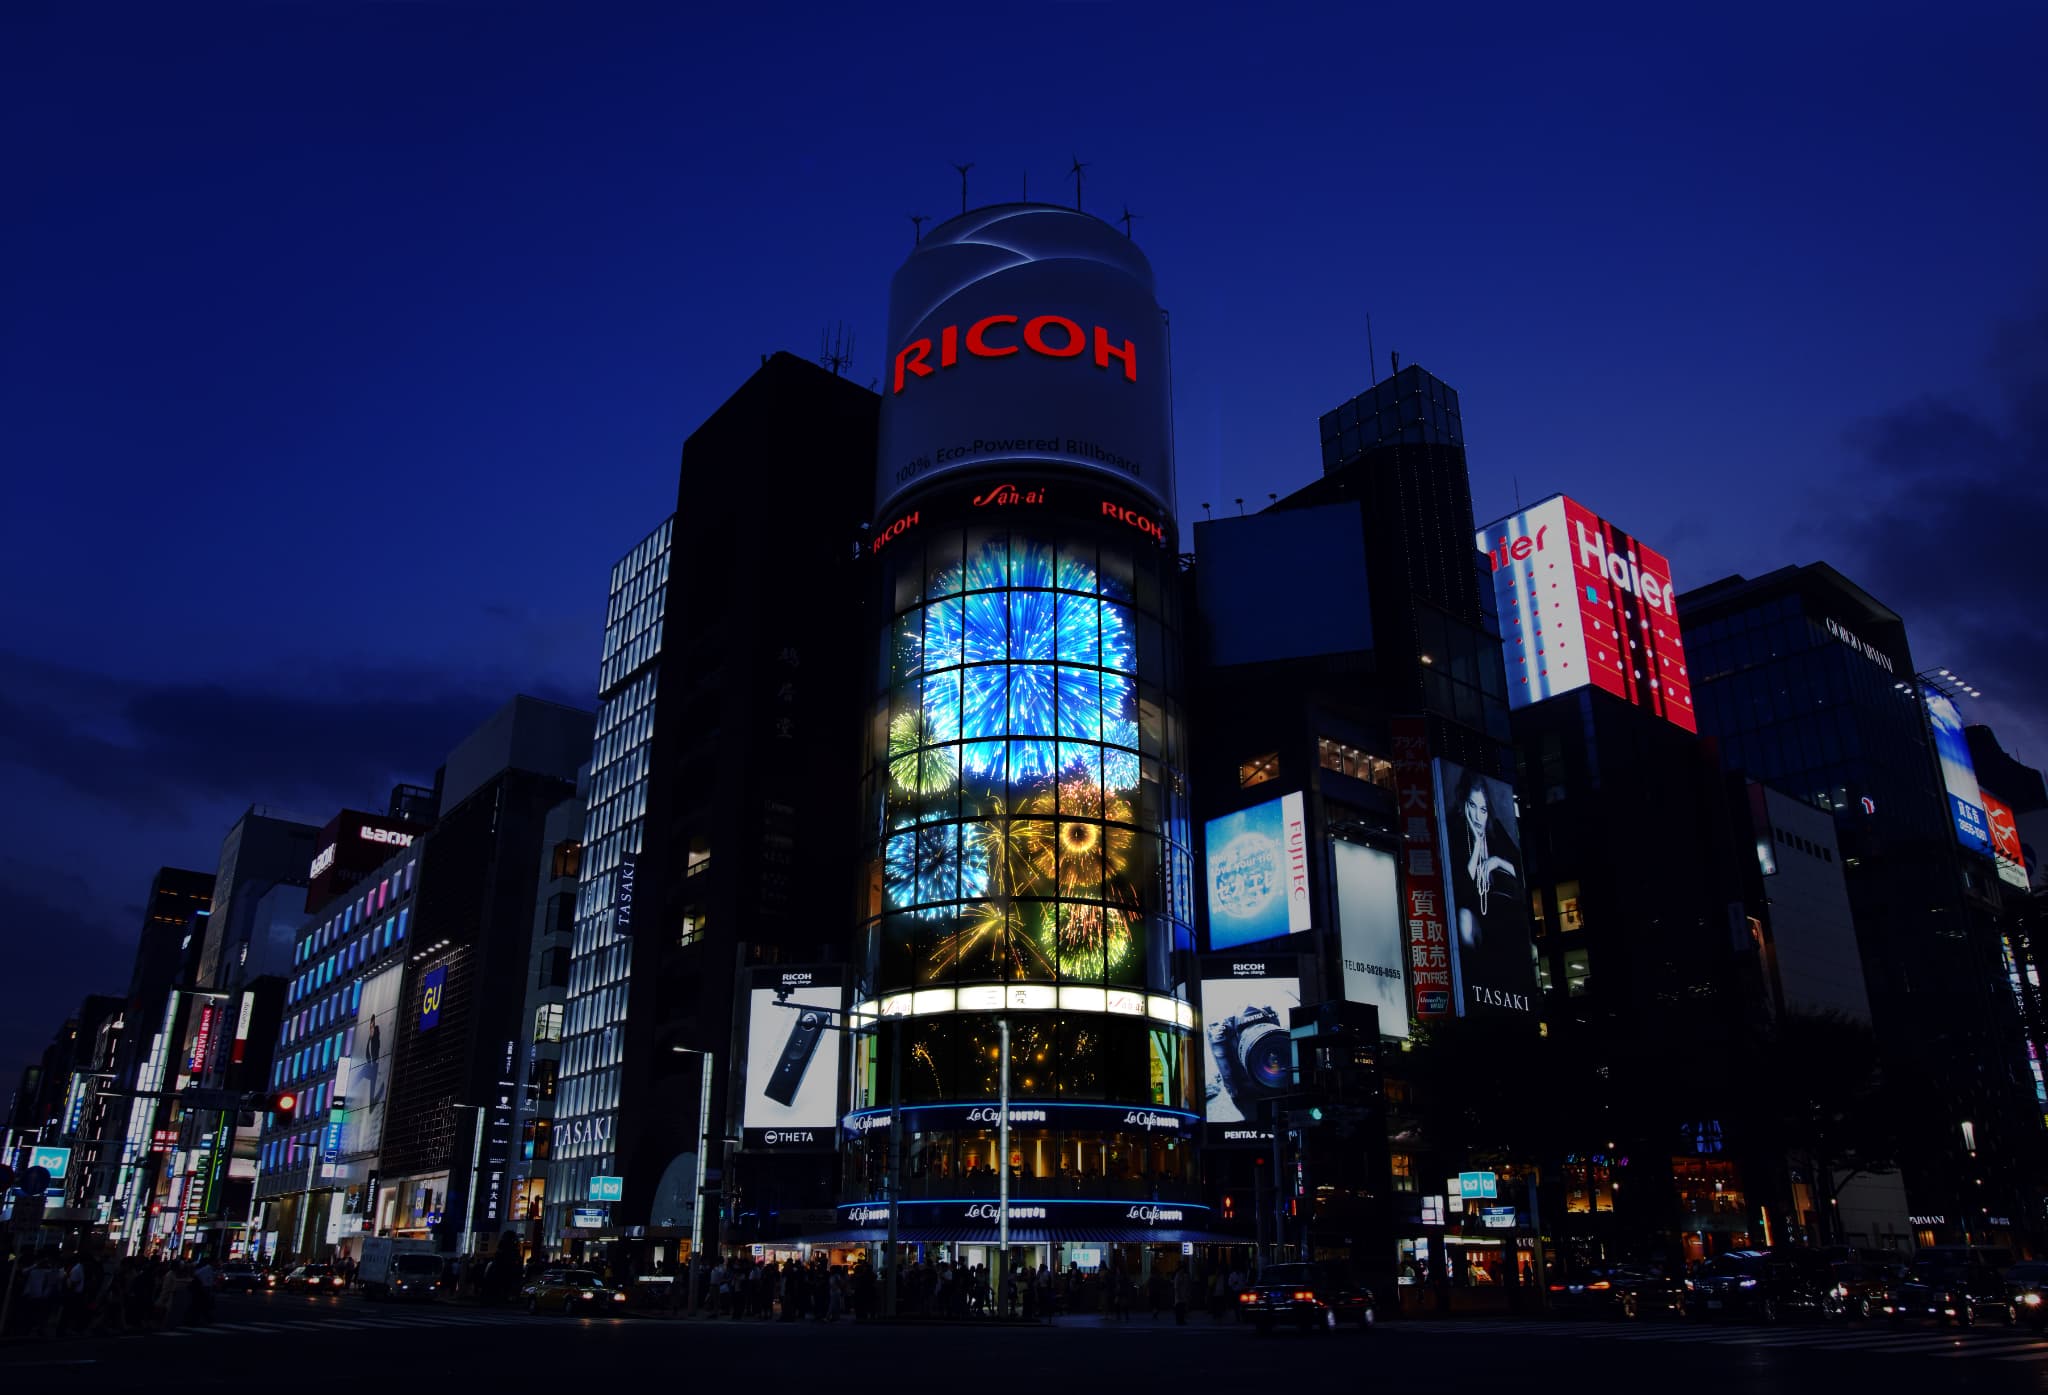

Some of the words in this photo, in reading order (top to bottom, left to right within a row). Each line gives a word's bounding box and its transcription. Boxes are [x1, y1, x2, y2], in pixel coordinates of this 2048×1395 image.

[894, 315, 1137, 394] RICOH
[896, 457, 931, 482] 100%
[937, 437, 1060, 464] Eco-Powered
[1066, 439, 1141, 476] Billboard
[873, 511, 920, 553] RICOH
[1102, 501, 1162, 540] RICOH
[1576, 520, 1674, 616] Haier
[1402, 784, 1435, 877] 大黒屋
[1288, 820, 1306, 902] FUJITEC
[618, 861, 636, 927] TASAKI
[1411, 889, 1438, 917] 質
[1409, 919, 1444, 943] 買取
[1233, 963, 1265, 971] RICOH
[1411, 944, 1448, 969] 販売
[782, 973, 812, 981] RICOH
[423, 983, 442, 1015] GU
[1471, 984, 1530, 1012] TASAKI
[966, 1108, 981, 1121] Le
[982, 1107, 1001, 1127] Caf
[1123, 1111, 1137, 1124] Le
[1136, 1112, 1158, 1131] Café
[553, 1116, 612, 1147] TASAKI
[778, 1131, 814, 1142] THETA
[1224, 1130, 1257, 1139] PENTAX
[964, 1204, 980, 1218] Le
[980, 1204, 1000, 1224] Caf
[1126, 1206, 1139, 1219] Le
[1139, 1206, 1160, 1225] Café
